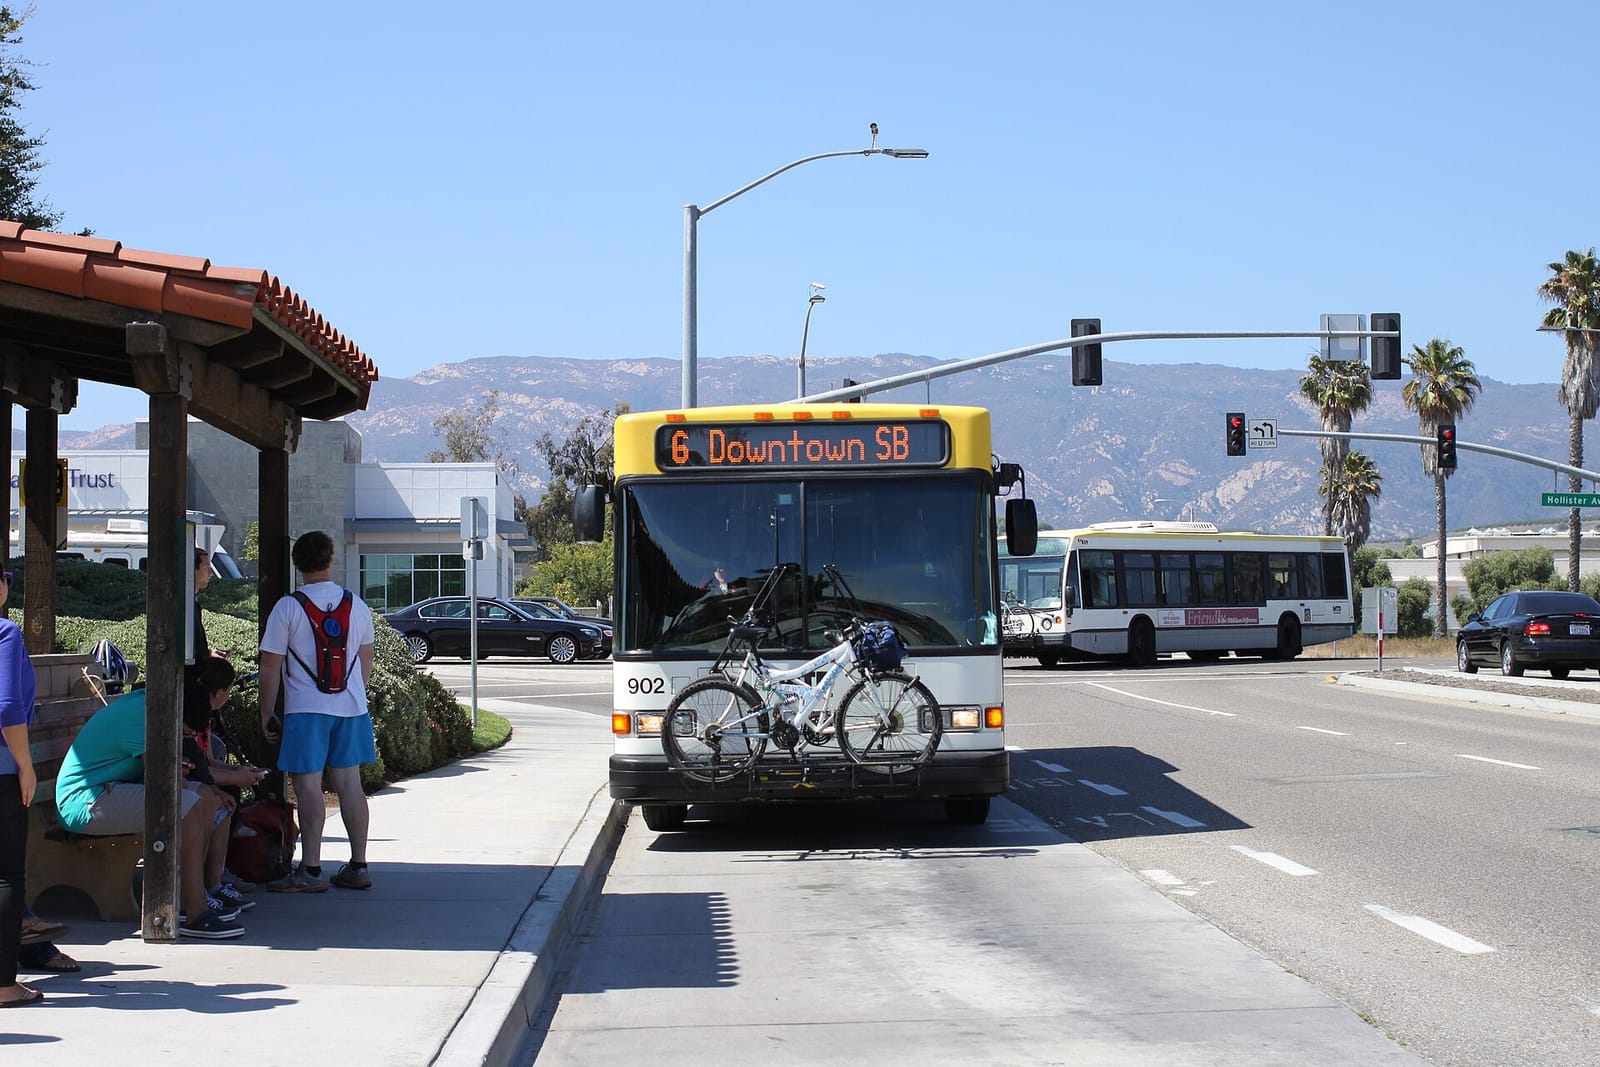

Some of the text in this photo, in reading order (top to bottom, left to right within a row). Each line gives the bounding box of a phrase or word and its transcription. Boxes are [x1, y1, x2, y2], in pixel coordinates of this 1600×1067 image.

[671, 425, 910, 464] 6 Downtown SB
[69, 468, 115, 489] Trust
[1547, 495, 1587, 505] Hollister
[627, 677, 666, 695] 902
